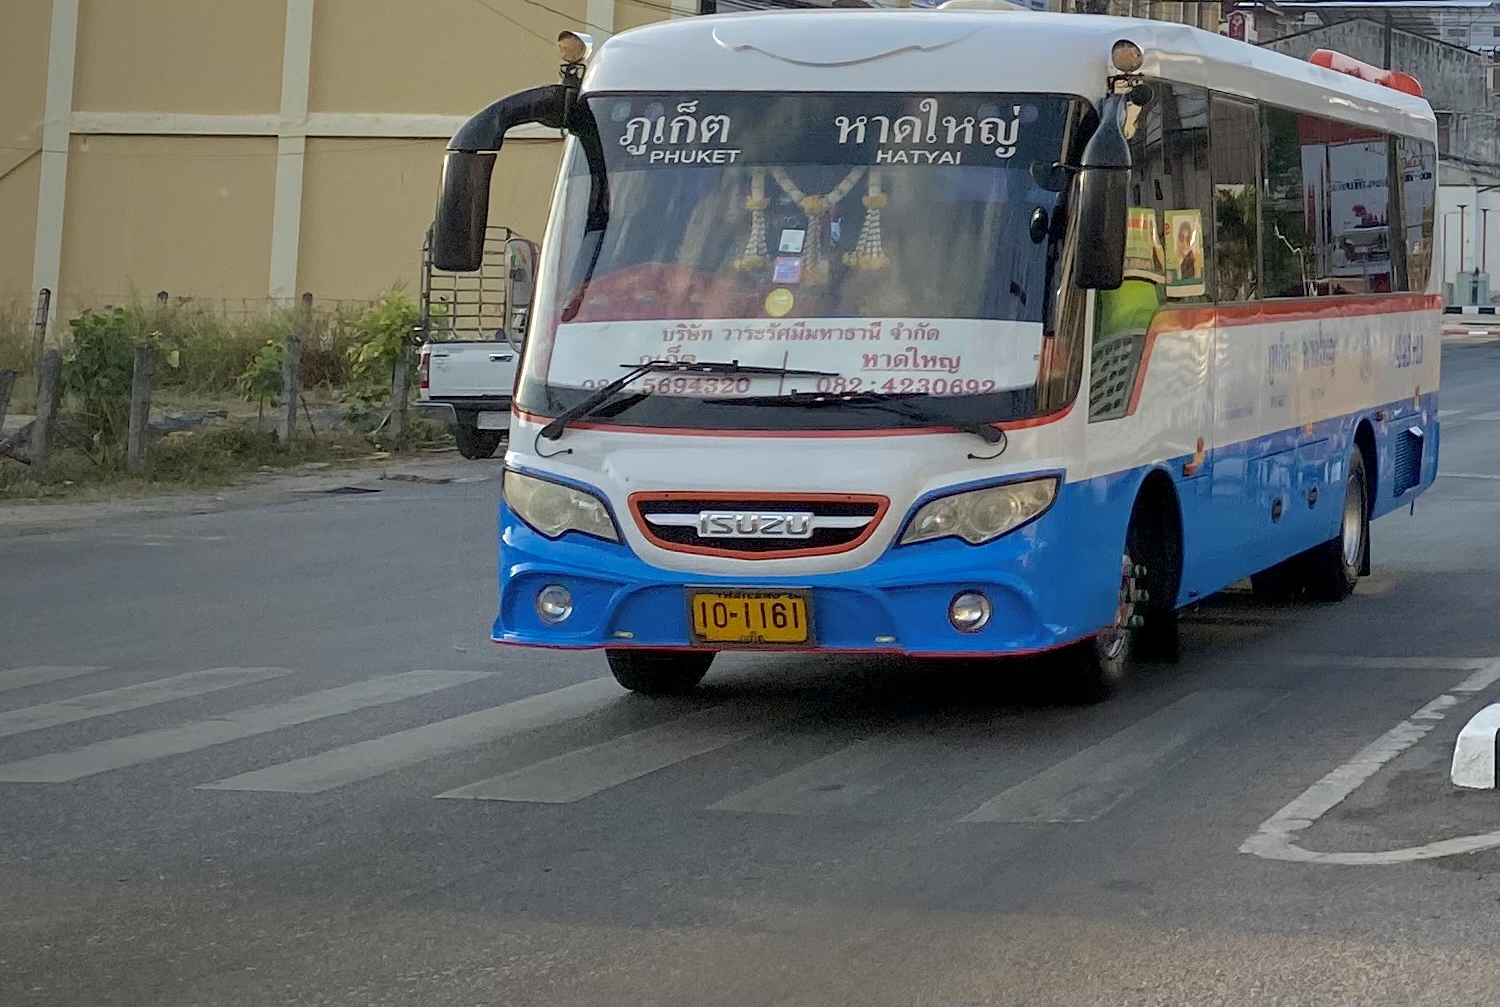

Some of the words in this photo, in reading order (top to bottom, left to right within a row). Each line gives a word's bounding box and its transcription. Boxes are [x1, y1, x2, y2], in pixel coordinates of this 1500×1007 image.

[619, 99, 732, 156] ภูเก็ต
[834, 98, 1022, 159] หาดใหญ่
[650, 150, 741, 164] PHUKET
[877, 150, 962, 165] HATYAI
[662, 324, 712, 342] บริษัท
[890, 322, 940, 341] จำกัด
[700, 514, 810, 535] ISUZU
[701, 601, 799, 629] 10-1161
